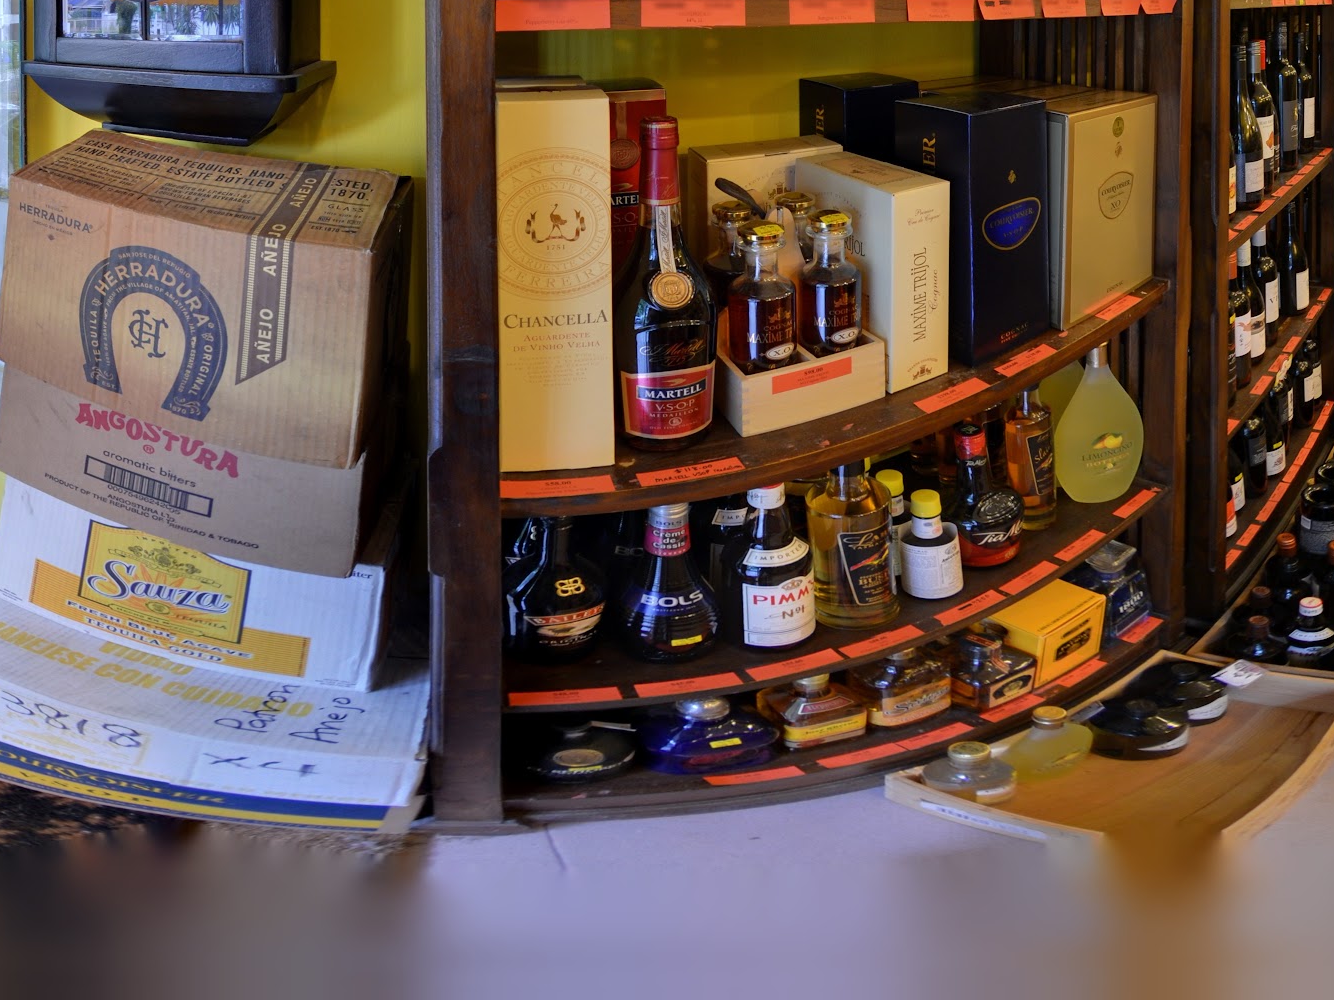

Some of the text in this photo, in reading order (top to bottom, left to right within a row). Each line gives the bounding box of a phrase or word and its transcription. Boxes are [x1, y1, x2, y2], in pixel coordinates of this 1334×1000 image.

[85, 139, 113, 151] CASA
[114, 144, 180, 166] HERRADURA
[167, 166, 211, 182] ESTATE
[215, 173, 275, 189] BOTTLED
[289, 176, 318, 208] AÑEJO
[1110, 199, 1122, 210] XO
[19, 201, 91, 234] HERRADURA
[118, 252, 131, 260] SAN
[149, 253, 161, 262] DEL
[162, 257, 192, 279] REFUGIO
[503, 261, 610, 288] FERREIRA
[94, 261, 210, 328] HERRADURA
[127, 282, 154, 290] VILLAGE
[503, 309, 609, 329] CHANCELLA
[91, 309, 102, 362] TEQUILA
[256, 308, 274, 364] AÑEJO
[524, 332, 591, 342] AGUARDENTE
[530, 343, 564, 351] VINHO
[567, 340, 601, 348] VELHA
[188, 344, 214, 396] ORIGINAL
[644, 383, 703, 399] MARTELL
[75, 403, 240, 479] ANGOSTURA
[1081, 441, 1134, 462] LIMONCINO
[103, 450, 150, 473] aromatic
[44, 472, 79, 491] PRODUCT
[80, 487, 91, 496] OF
[93, 492, 108, 503] THE
[108, 498, 150, 519] REPUBLIC
[152, 514, 165, 524] OF
[166, 520, 206, 537] TRINIDAD
[217, 535, 259, 550] TOBAGO
[107, 493, 159, 516] ANGOSTURA
[655, 519, 683, 527] BOLS
[652, 540, 686, 550] Cassis
[753, 543, 803, 561] IMPORTED
[86, 559, 231, 615] Sauza
[640, 590, 704, 607] BOLS
[1118, 590, 1144, 613] 1800
[66, 600, 121, 624] FRESH
[127, 618, 179, 639] BLUE
[180, 637, 254, 660] AGAVE
[84, 617, 162, 648] TEQUILA
[168, 644, 224, 663] GOLD
[93, 660, 163, 690] CON
